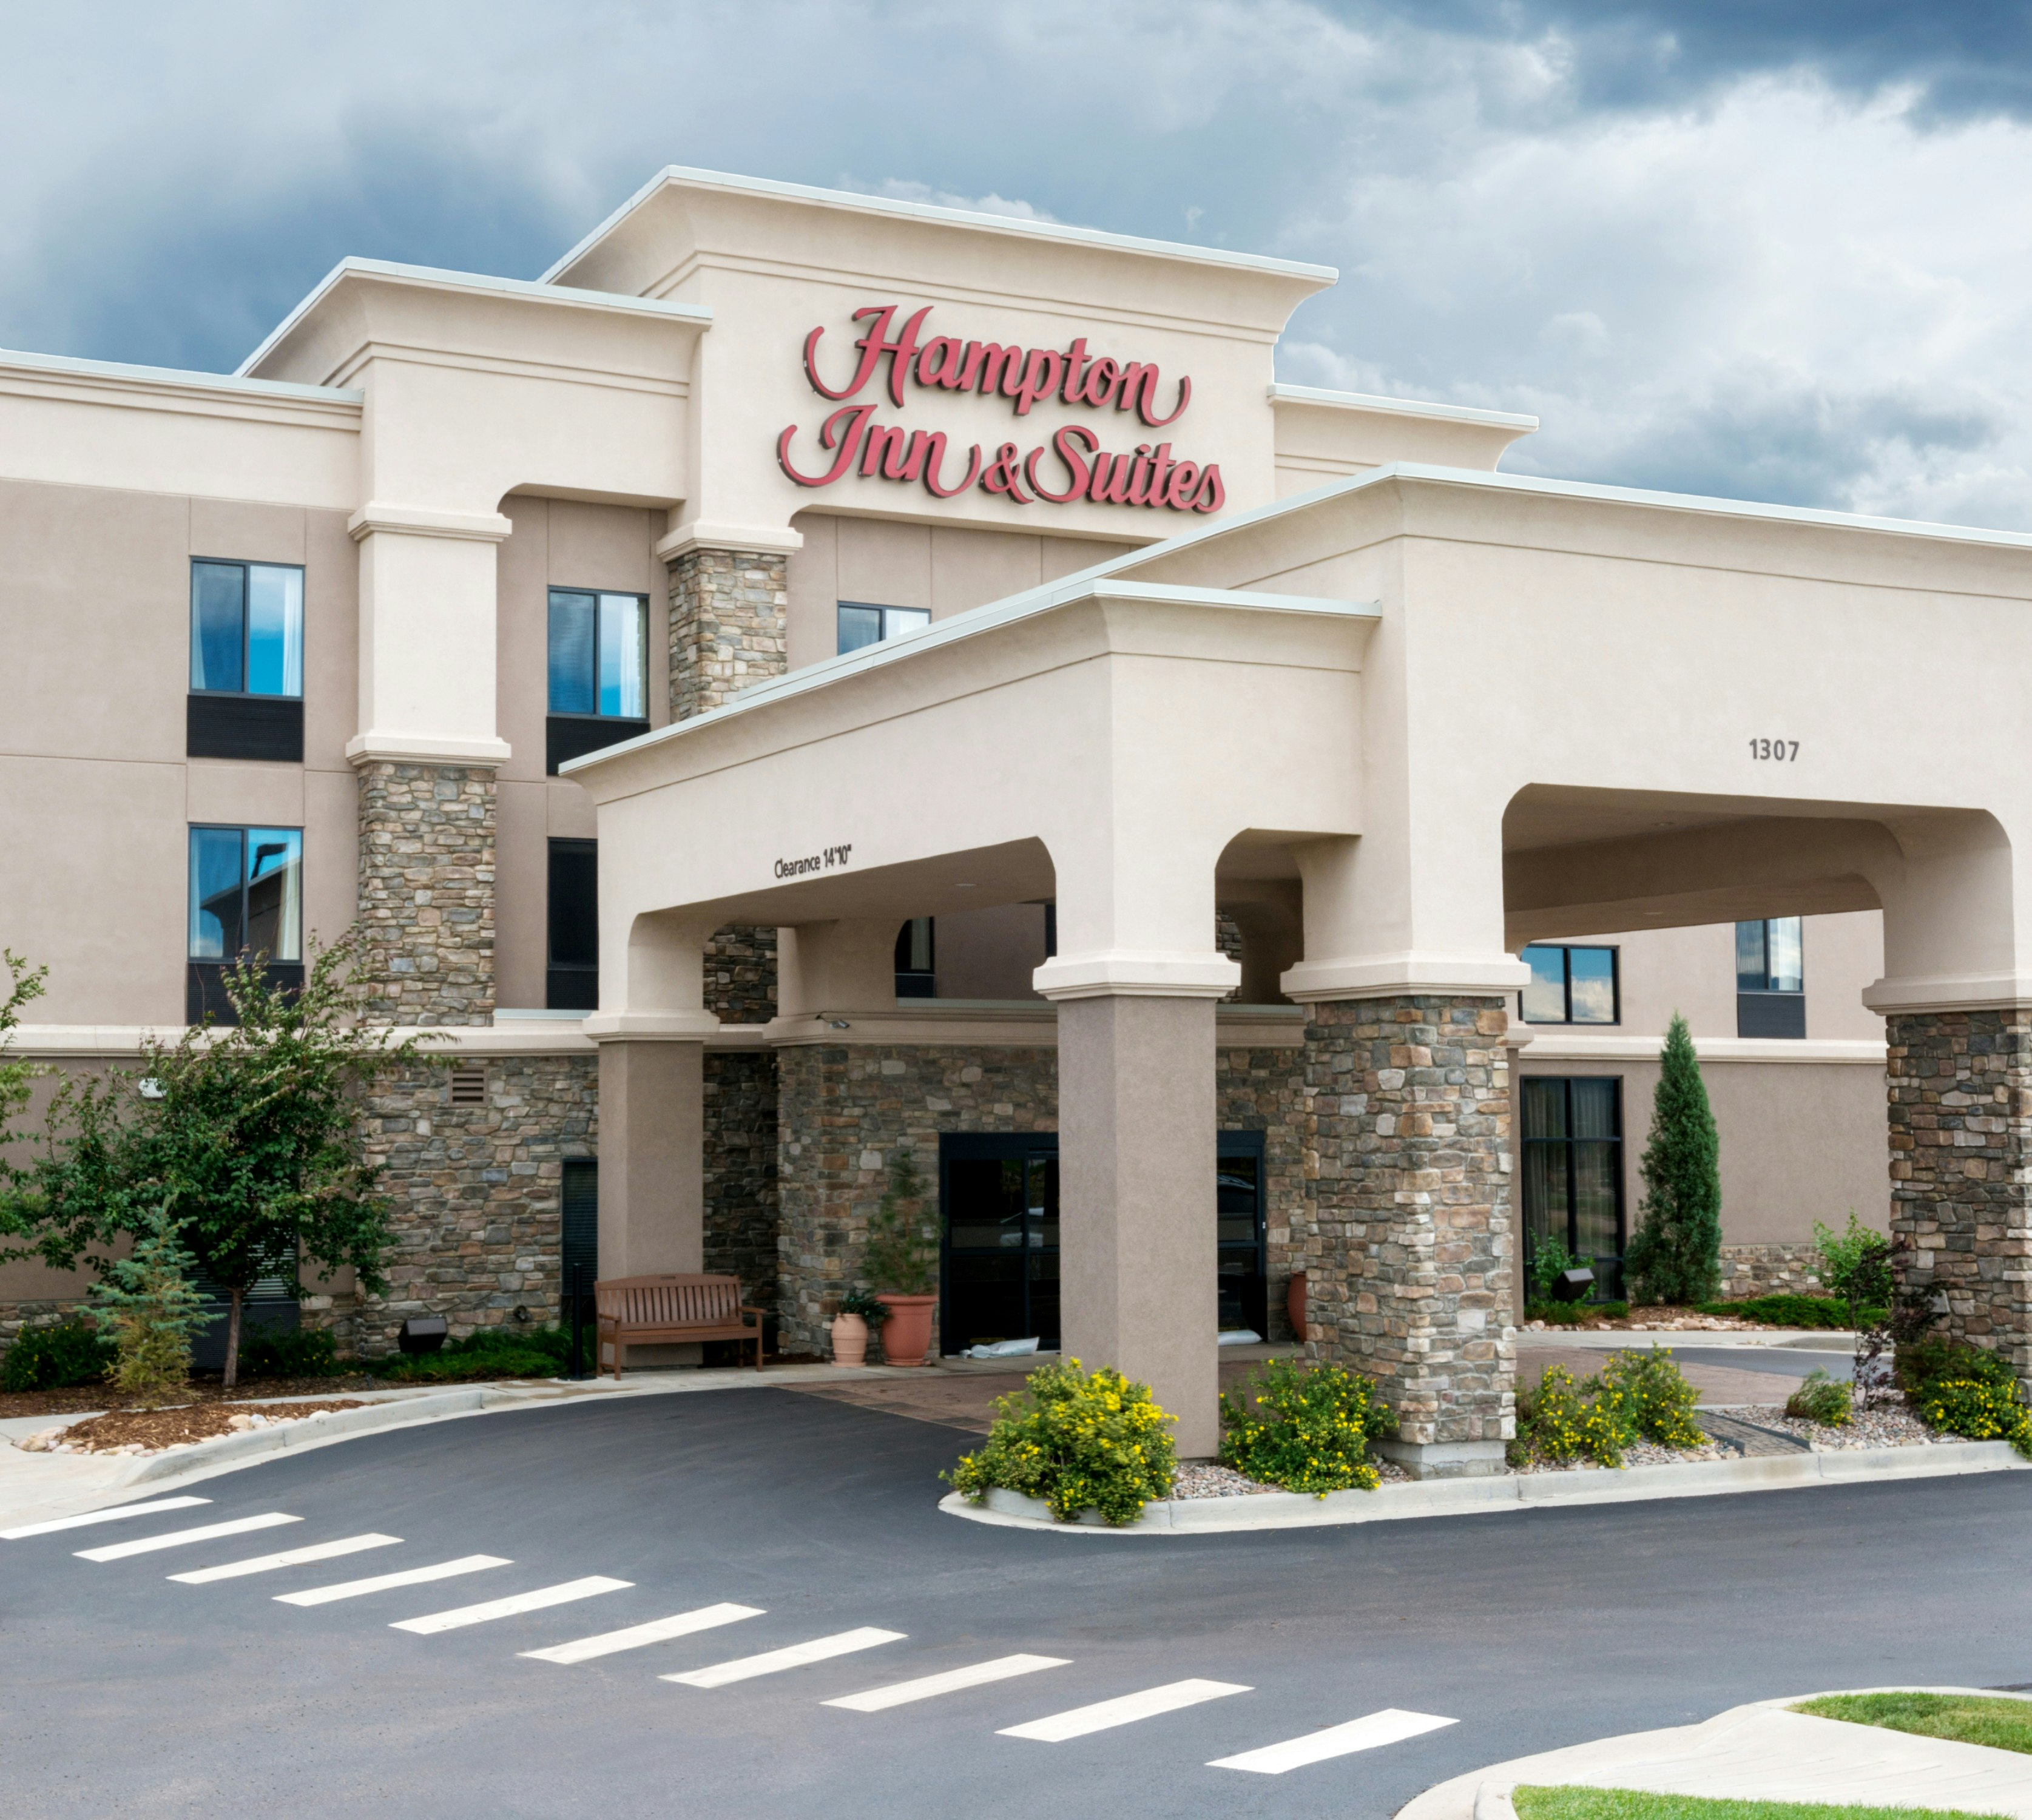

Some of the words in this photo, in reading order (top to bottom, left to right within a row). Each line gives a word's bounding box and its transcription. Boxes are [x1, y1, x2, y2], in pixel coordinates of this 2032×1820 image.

[803, 305, 1191, 427] Hampton
[777, 404, 981, 499] Inn
[979, 442, 1034, 505] &
[1025, 425, 1225, 514] Suites
[1749, 738, 1799, 761] 1307
[774, 855, 820, 878] Clearance
